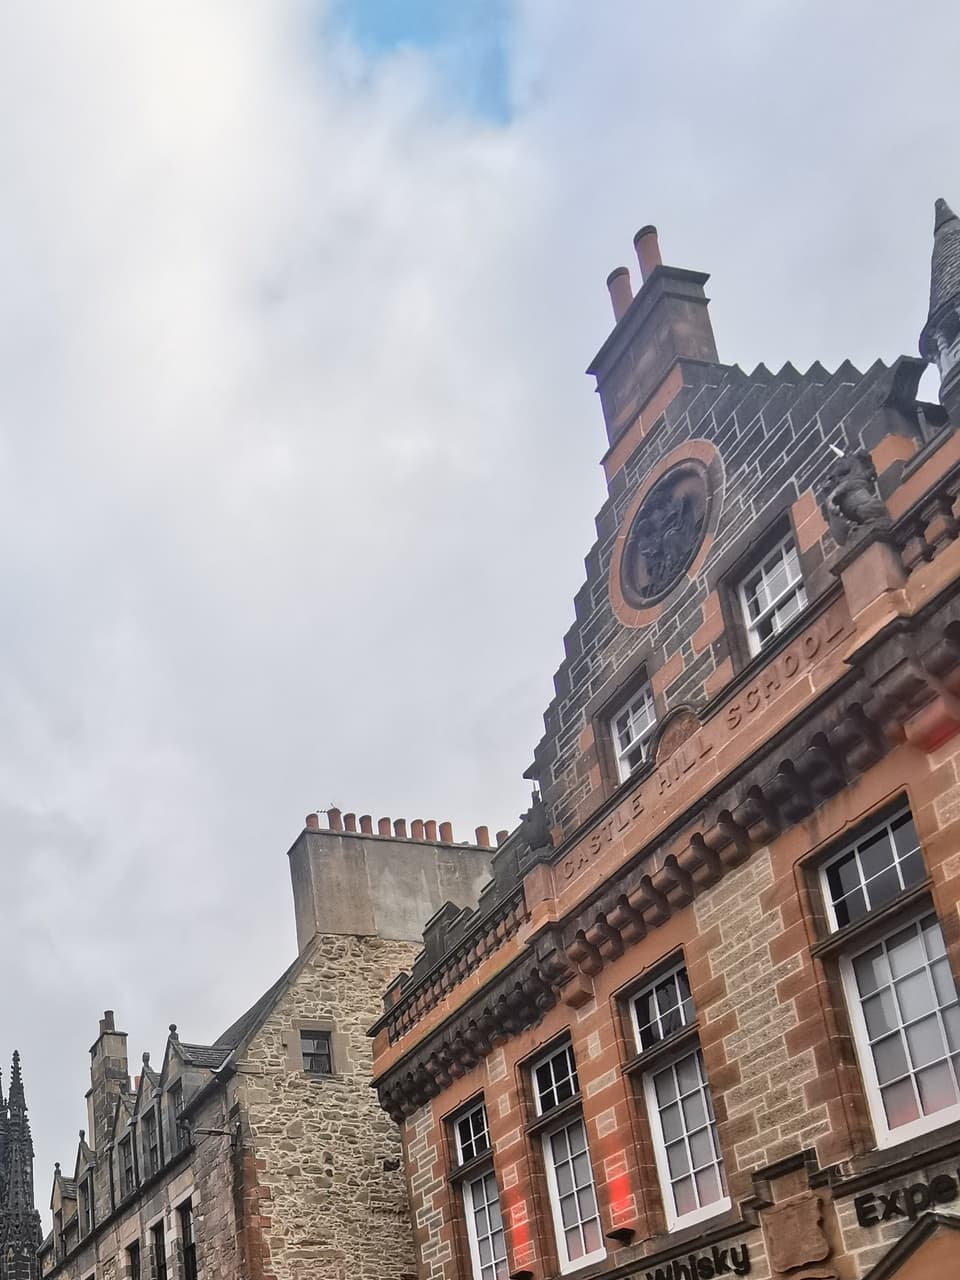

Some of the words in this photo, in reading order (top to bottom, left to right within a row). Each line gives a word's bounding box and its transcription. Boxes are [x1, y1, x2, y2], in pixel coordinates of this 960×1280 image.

[561, 794, 645, 880] CASTLE
[655, 741, 714, 796] HILL
[725, 620, 845, 731] SCHOOL
[854, 1171, 960, 1228] Expe
